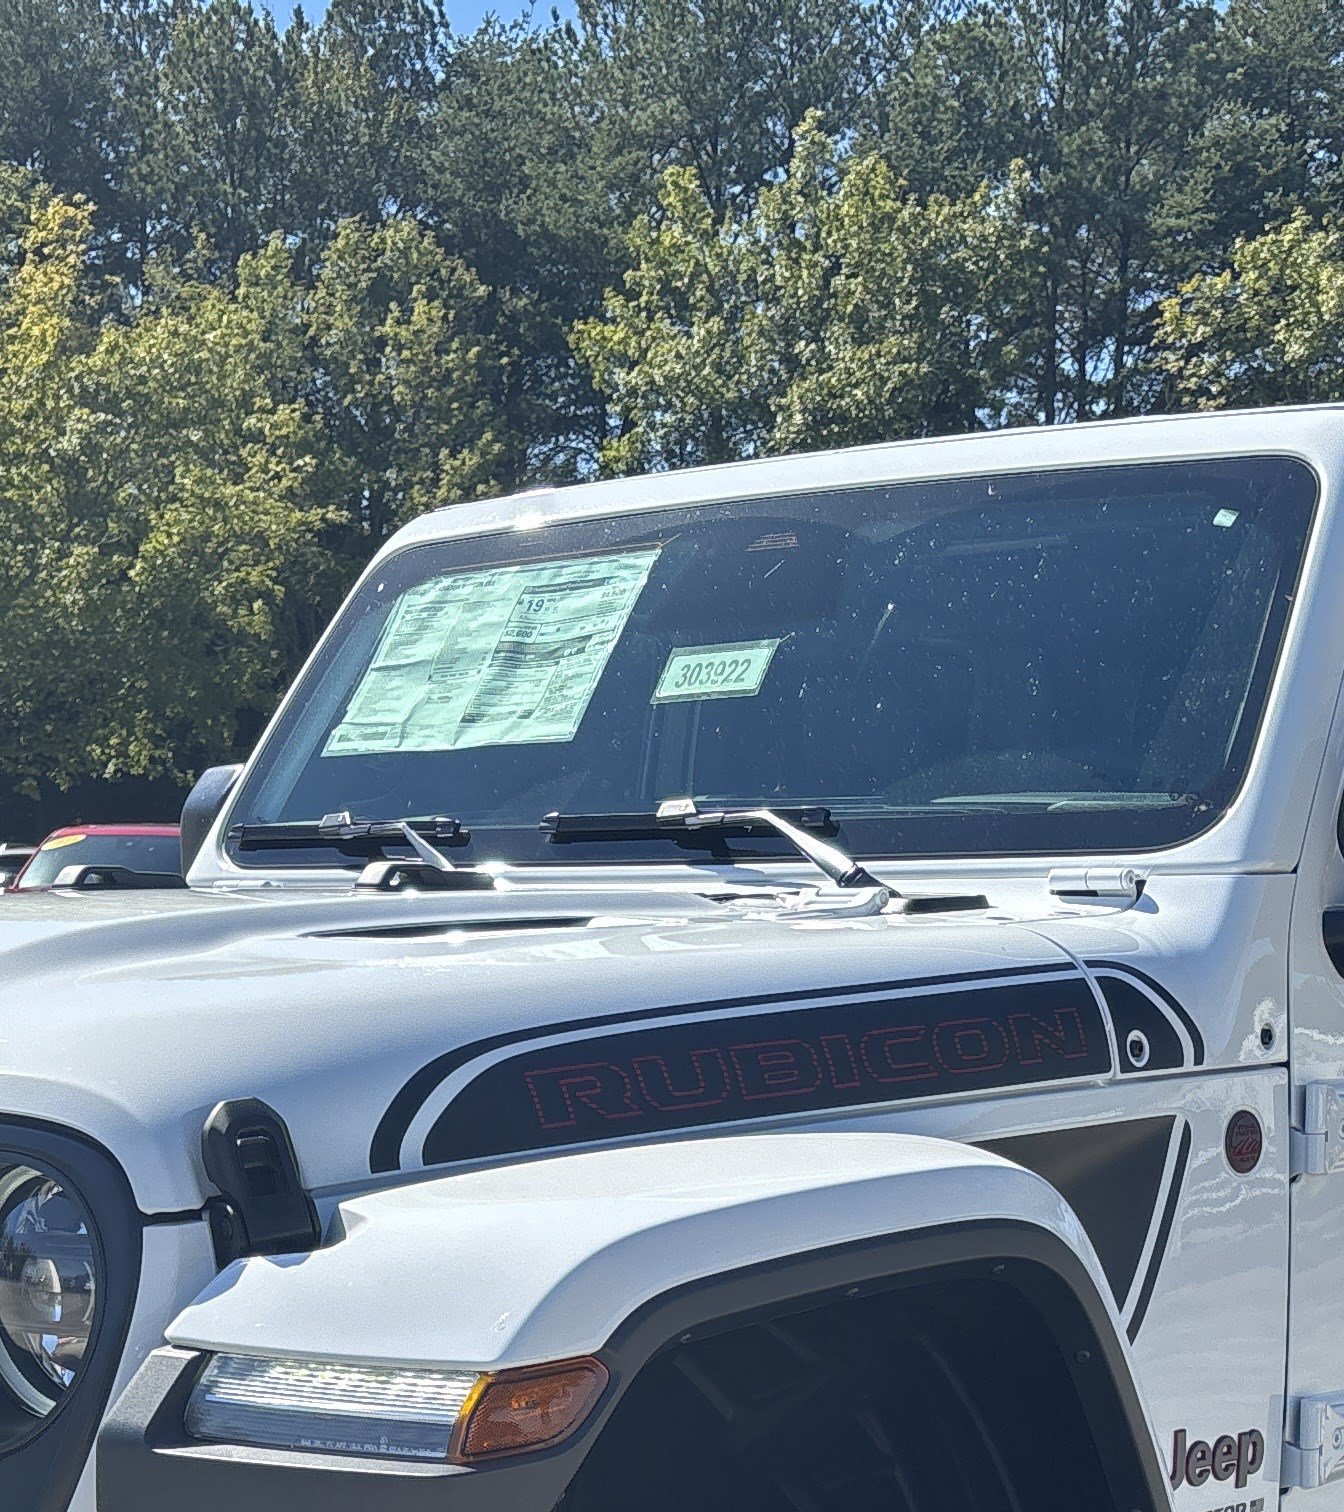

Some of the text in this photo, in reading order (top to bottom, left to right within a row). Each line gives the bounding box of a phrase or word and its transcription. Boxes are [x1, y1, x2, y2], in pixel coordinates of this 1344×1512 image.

[526, 599, 545, 613] 19
[674, 658, 752, 687] 303922
[524, 1007, 1089, 1130] RUBICON
[1170, 1428, 1265, 1492] Jeep
